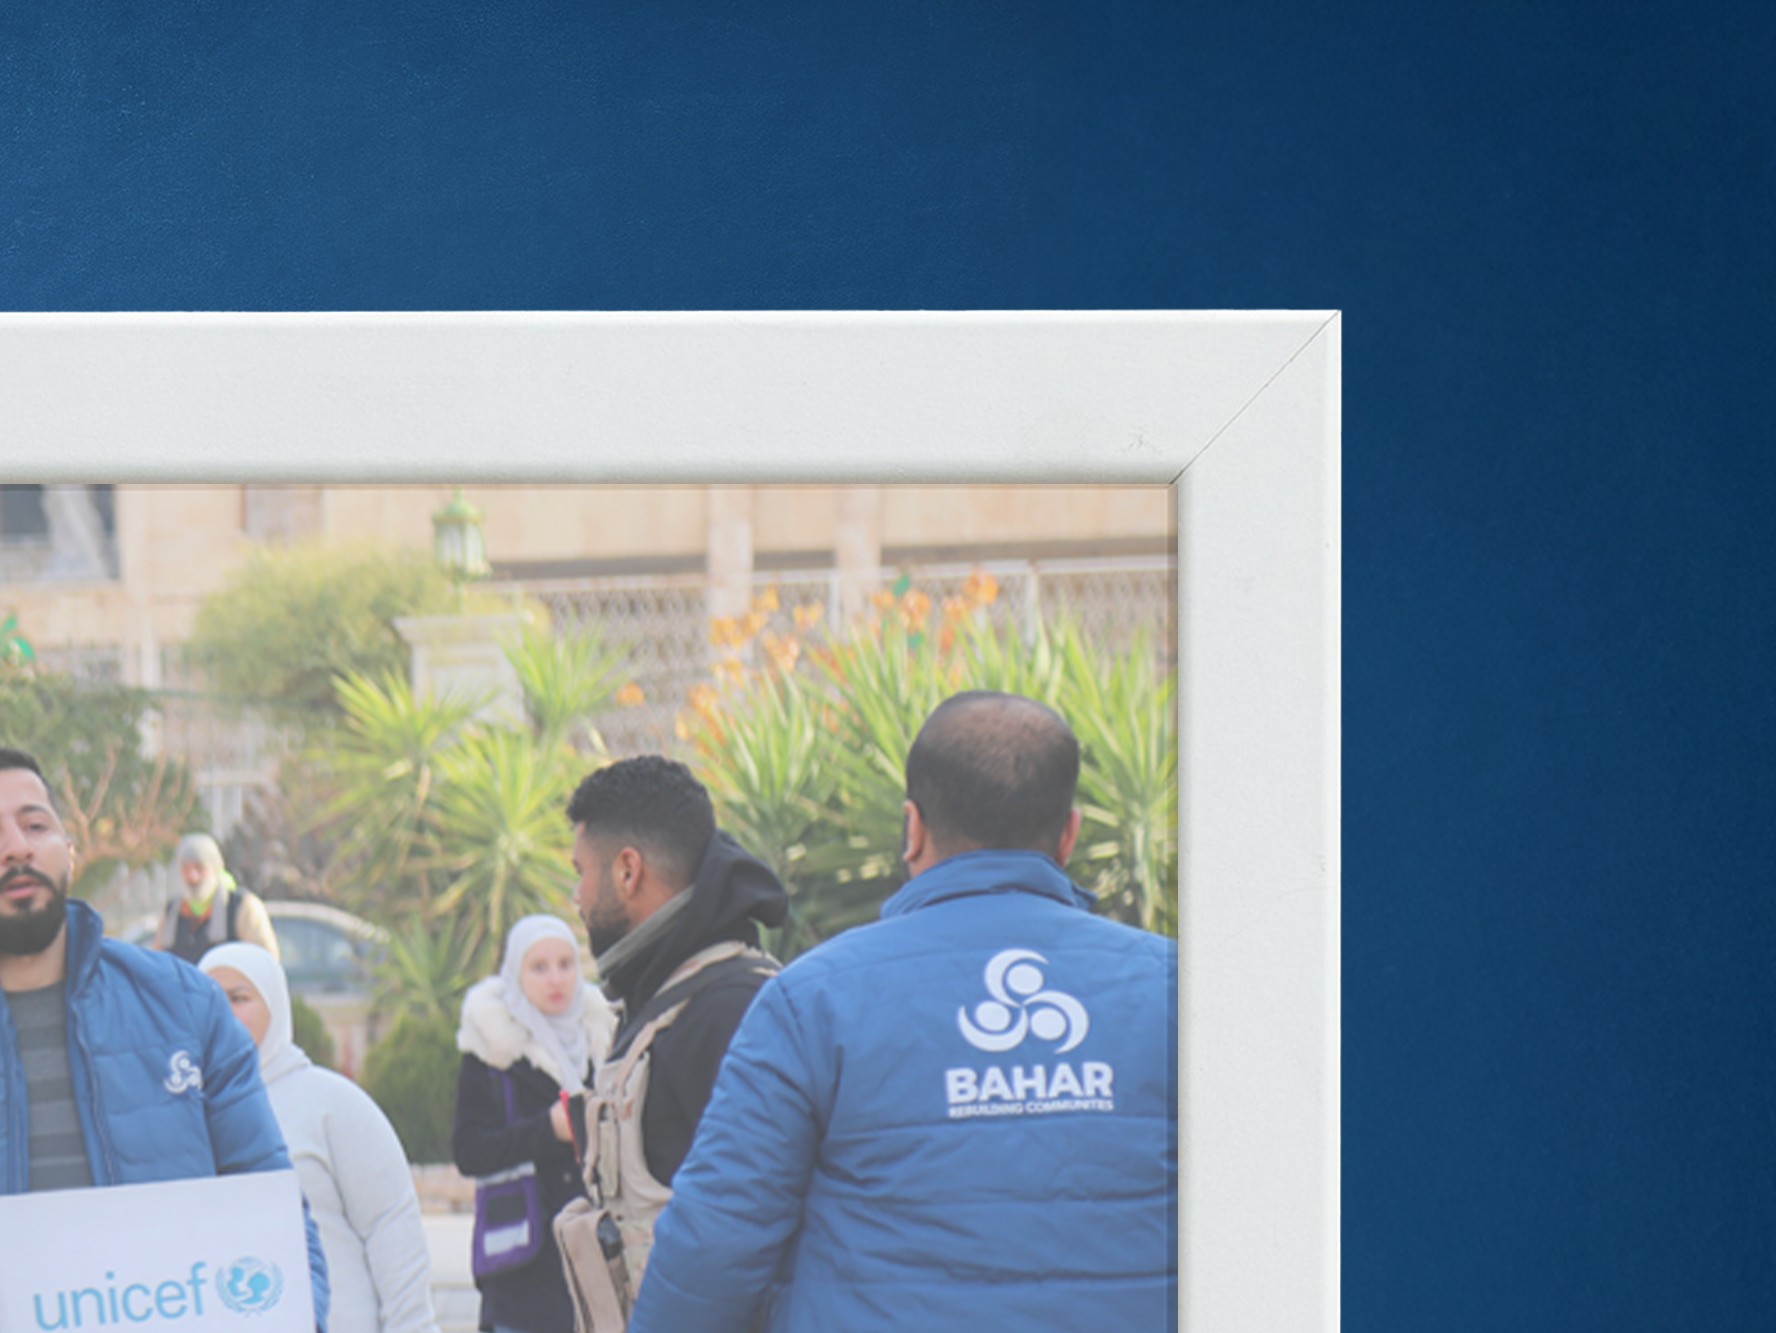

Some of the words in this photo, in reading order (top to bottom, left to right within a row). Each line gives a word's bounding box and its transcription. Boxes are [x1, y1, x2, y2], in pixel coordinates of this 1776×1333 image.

[945, 1061, 1114, 1104] BAHAR
[948, 1103, 1023, 1118] REBUILDING
[33, 1261, 208, 1331] unicef
